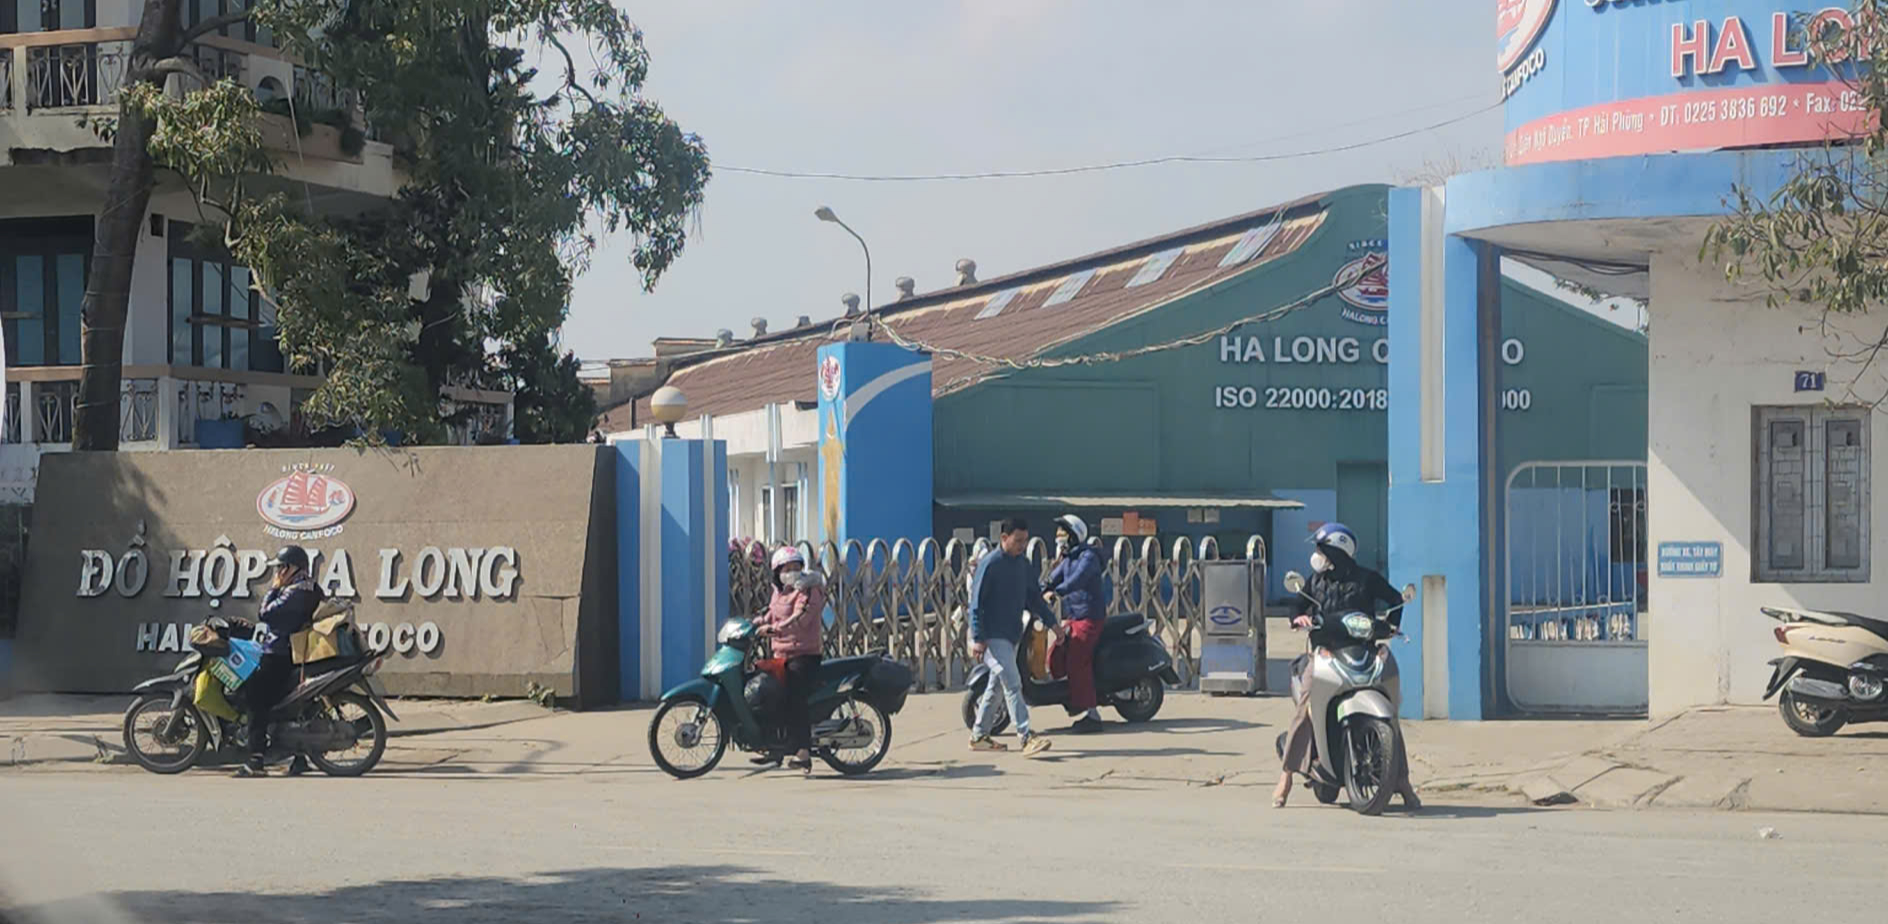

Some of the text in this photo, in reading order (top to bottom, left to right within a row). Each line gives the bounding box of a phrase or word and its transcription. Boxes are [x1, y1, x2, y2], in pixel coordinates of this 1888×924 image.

[1672, 16, 1755, 77] HA
[1578, 117, 1590, 136] TP
[1684, 98, 1716, 122] 0225
[1760, 95, 1788, 116] 692
[1220, 336, 1265, 363] HA
[1274, 336, 1360, 364] LONG
[1800, 373, 1817, 389] 71
[1216, 387, 1388, 410] ISO 22000:2018
[163, 534, 269, 608] HỘP
[375, 546, 518, 598] LONG
